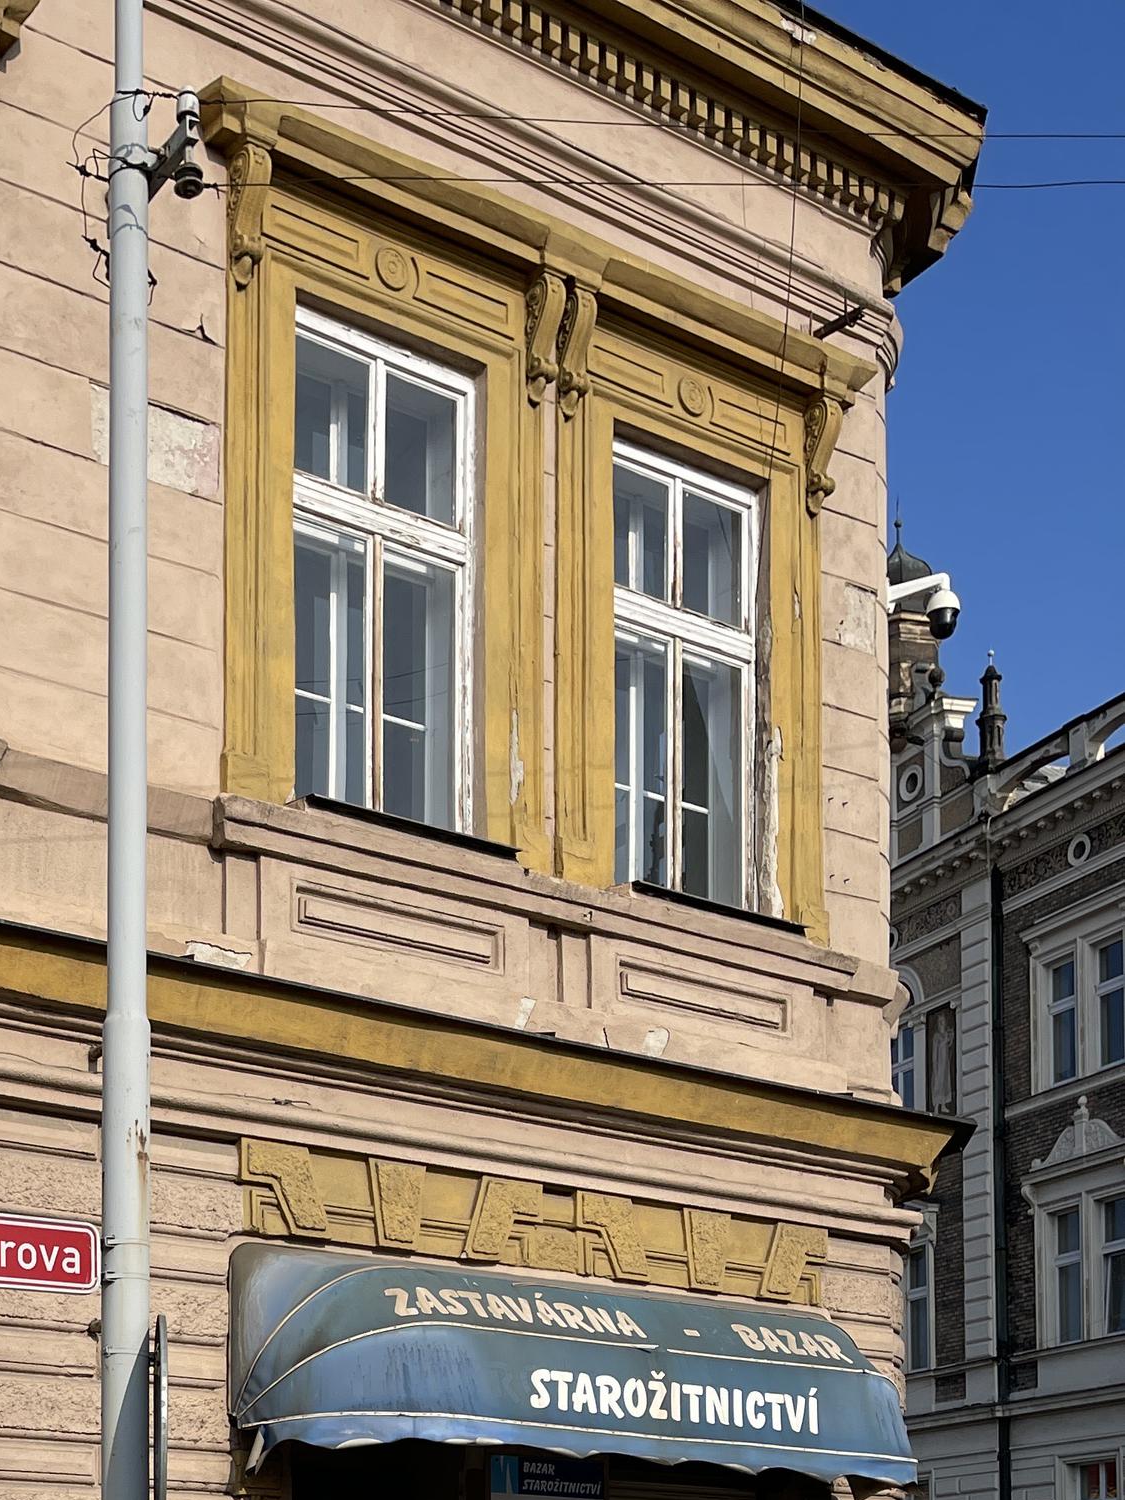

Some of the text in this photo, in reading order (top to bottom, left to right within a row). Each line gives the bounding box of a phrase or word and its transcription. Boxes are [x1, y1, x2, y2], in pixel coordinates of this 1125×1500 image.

[384, 1287, 647, 1338] ZASTAVÁRNA
[731, 1323, 853, 1364] BAZAR
[530, 1369, 819, 1435] STAROŽITNICTVÍ
[522, 1478, 602, 1495] STAROŽITNICTVÍ
[523, 1462, 555, 1475] BAZAR
